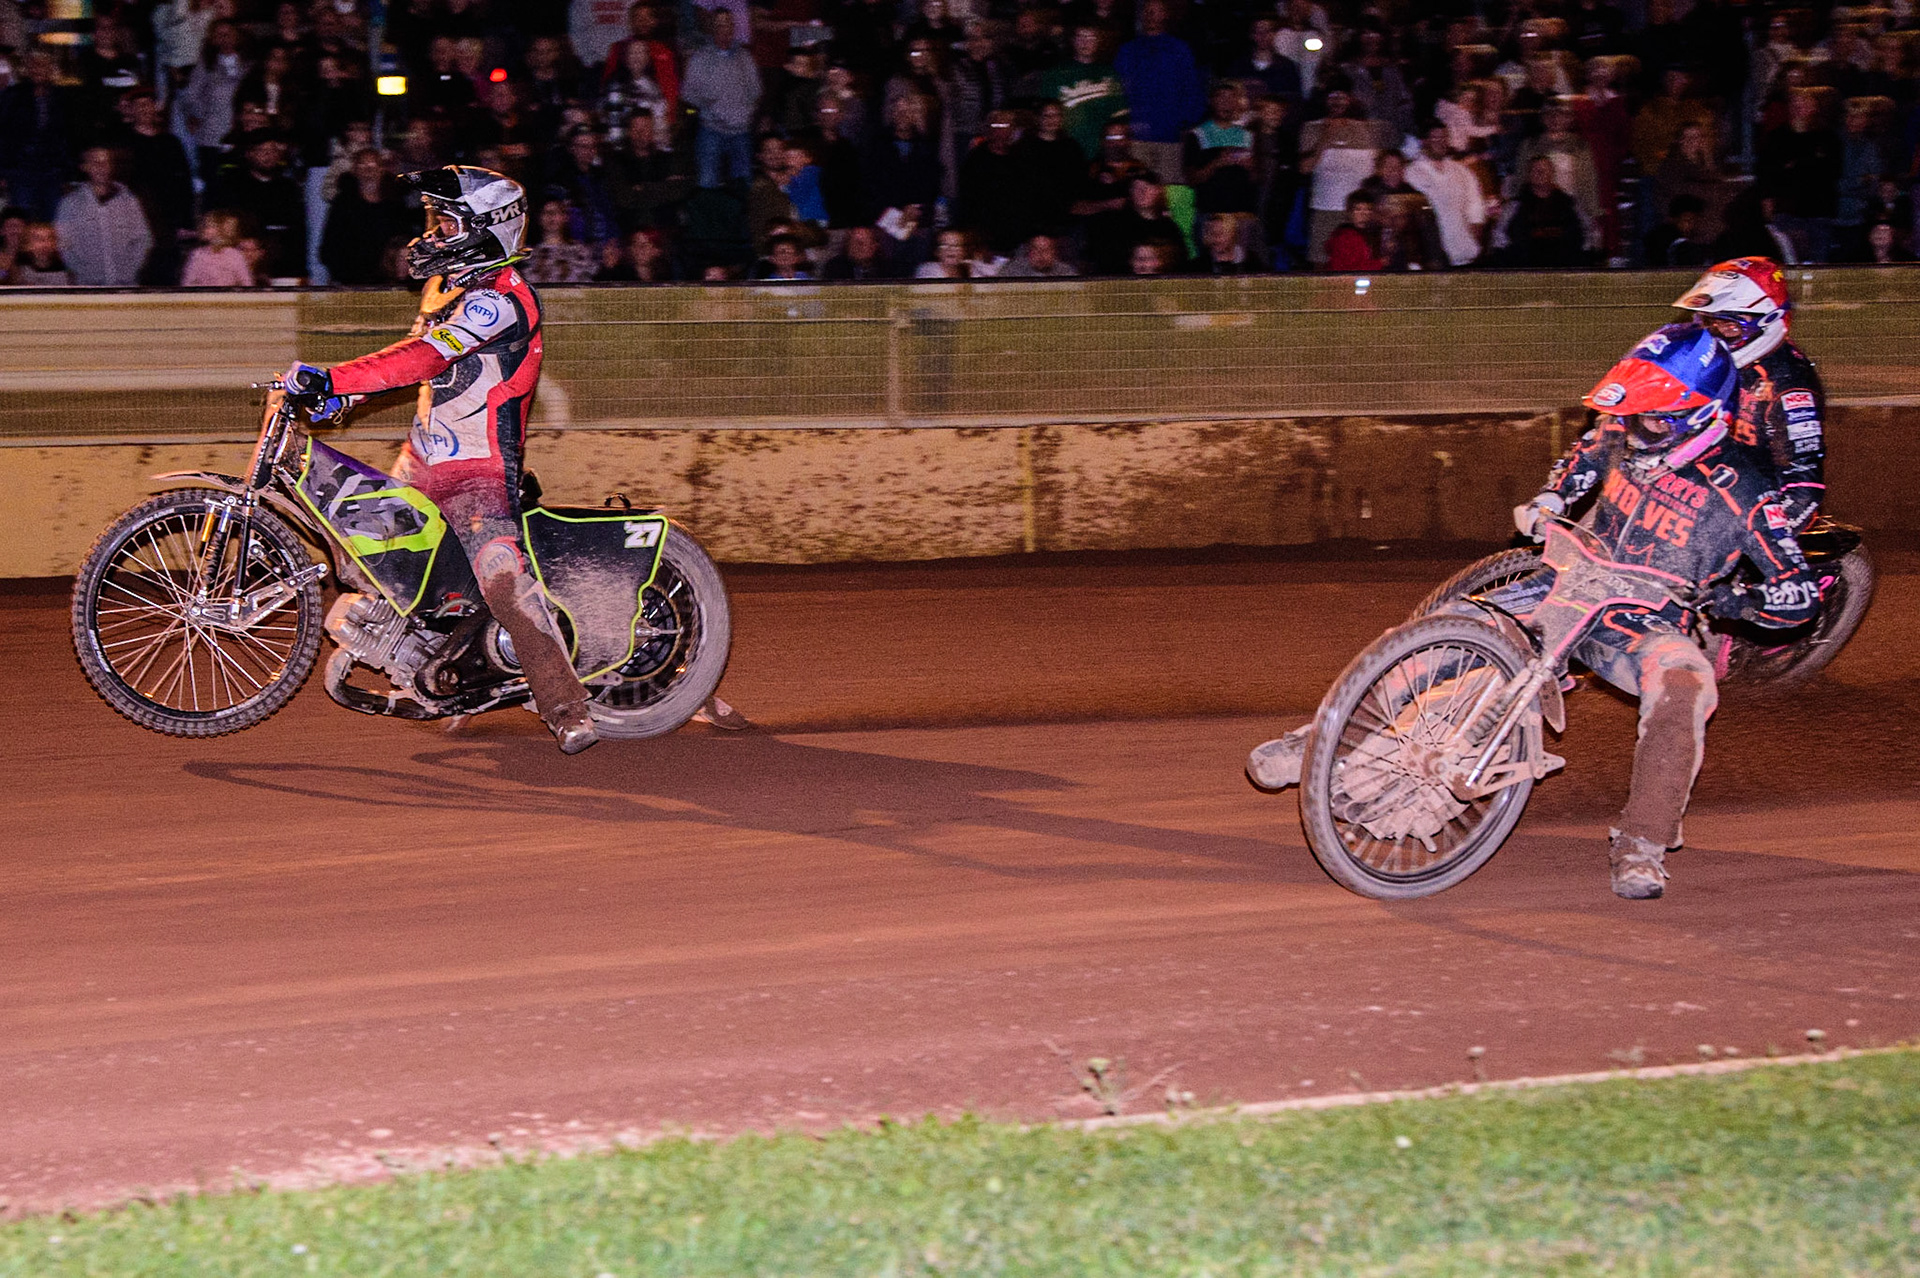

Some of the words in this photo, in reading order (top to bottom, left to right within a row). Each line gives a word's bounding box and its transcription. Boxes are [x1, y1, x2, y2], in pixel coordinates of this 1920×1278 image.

[469, 304, 493, 320] ATPI
[1655, 472, 1709, 509] RRYS
[1602, 467, 1695, 548] WOVES
[623, 520, 662, 549] 27
